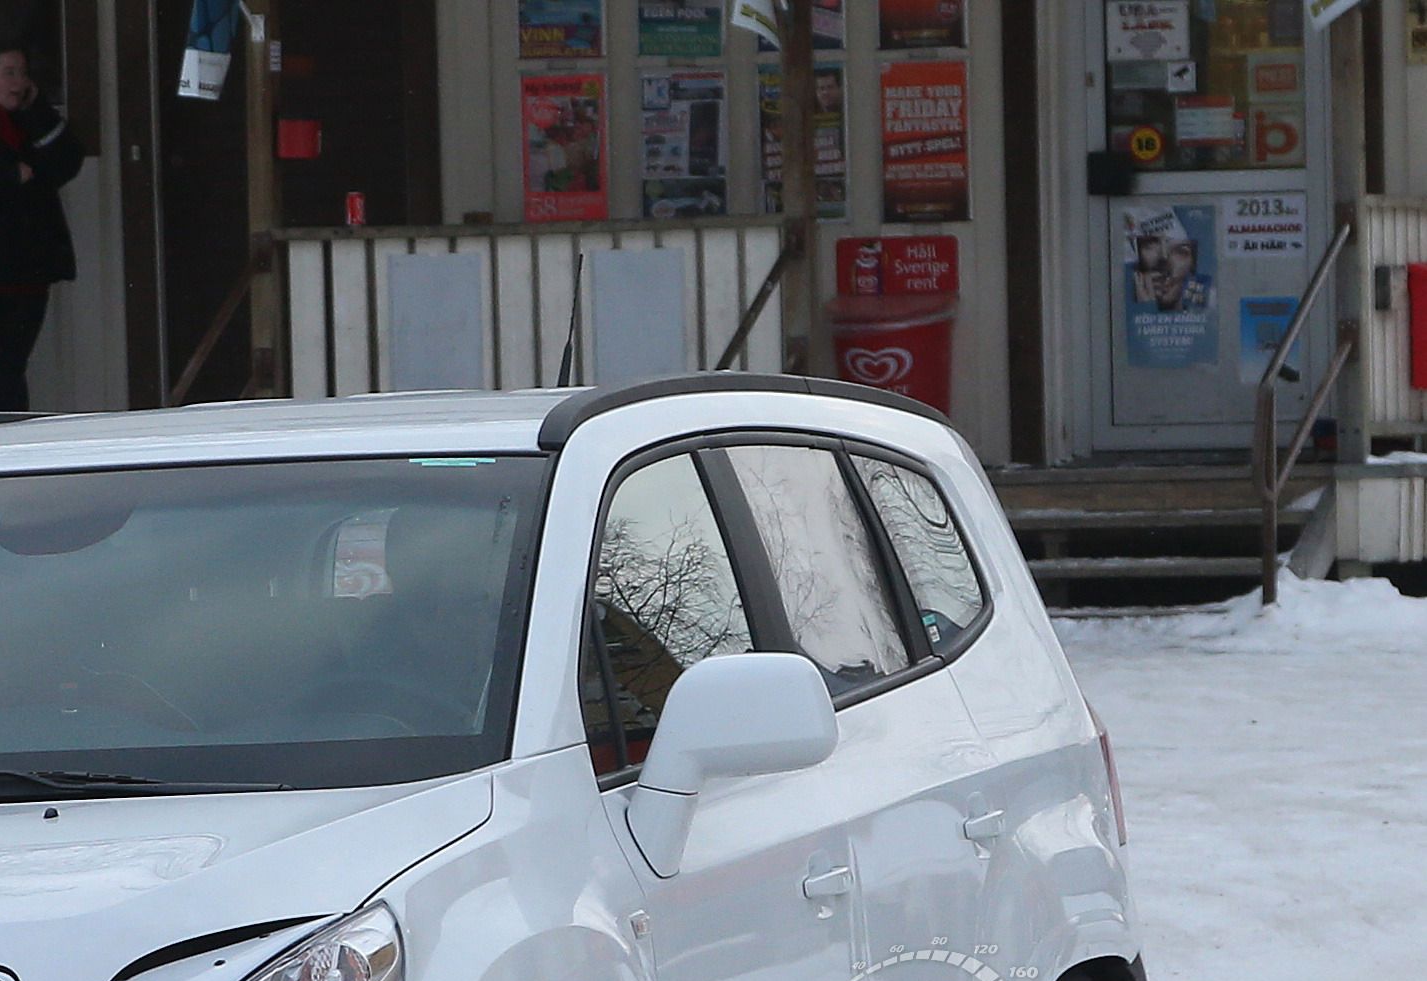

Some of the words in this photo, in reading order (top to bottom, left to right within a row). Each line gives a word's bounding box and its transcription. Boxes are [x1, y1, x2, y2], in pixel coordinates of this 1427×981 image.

[522, 27, 566, 42] VINN
[886, 86, 922, 98] MAKE
[926, 84, 963, 97] YOUR
[886, 98, 963, 118] FRIDAY
[886, 118, 963, 133] FANTASTIC
[1237, 198, 1283, 216] 2013
[1227, 223, 1302, 234] ALMANACKOR
[907, 243, 937, 259] Håll
[894, 259, 950, 277] Sverige
[906, 277, 939, 289] rent
